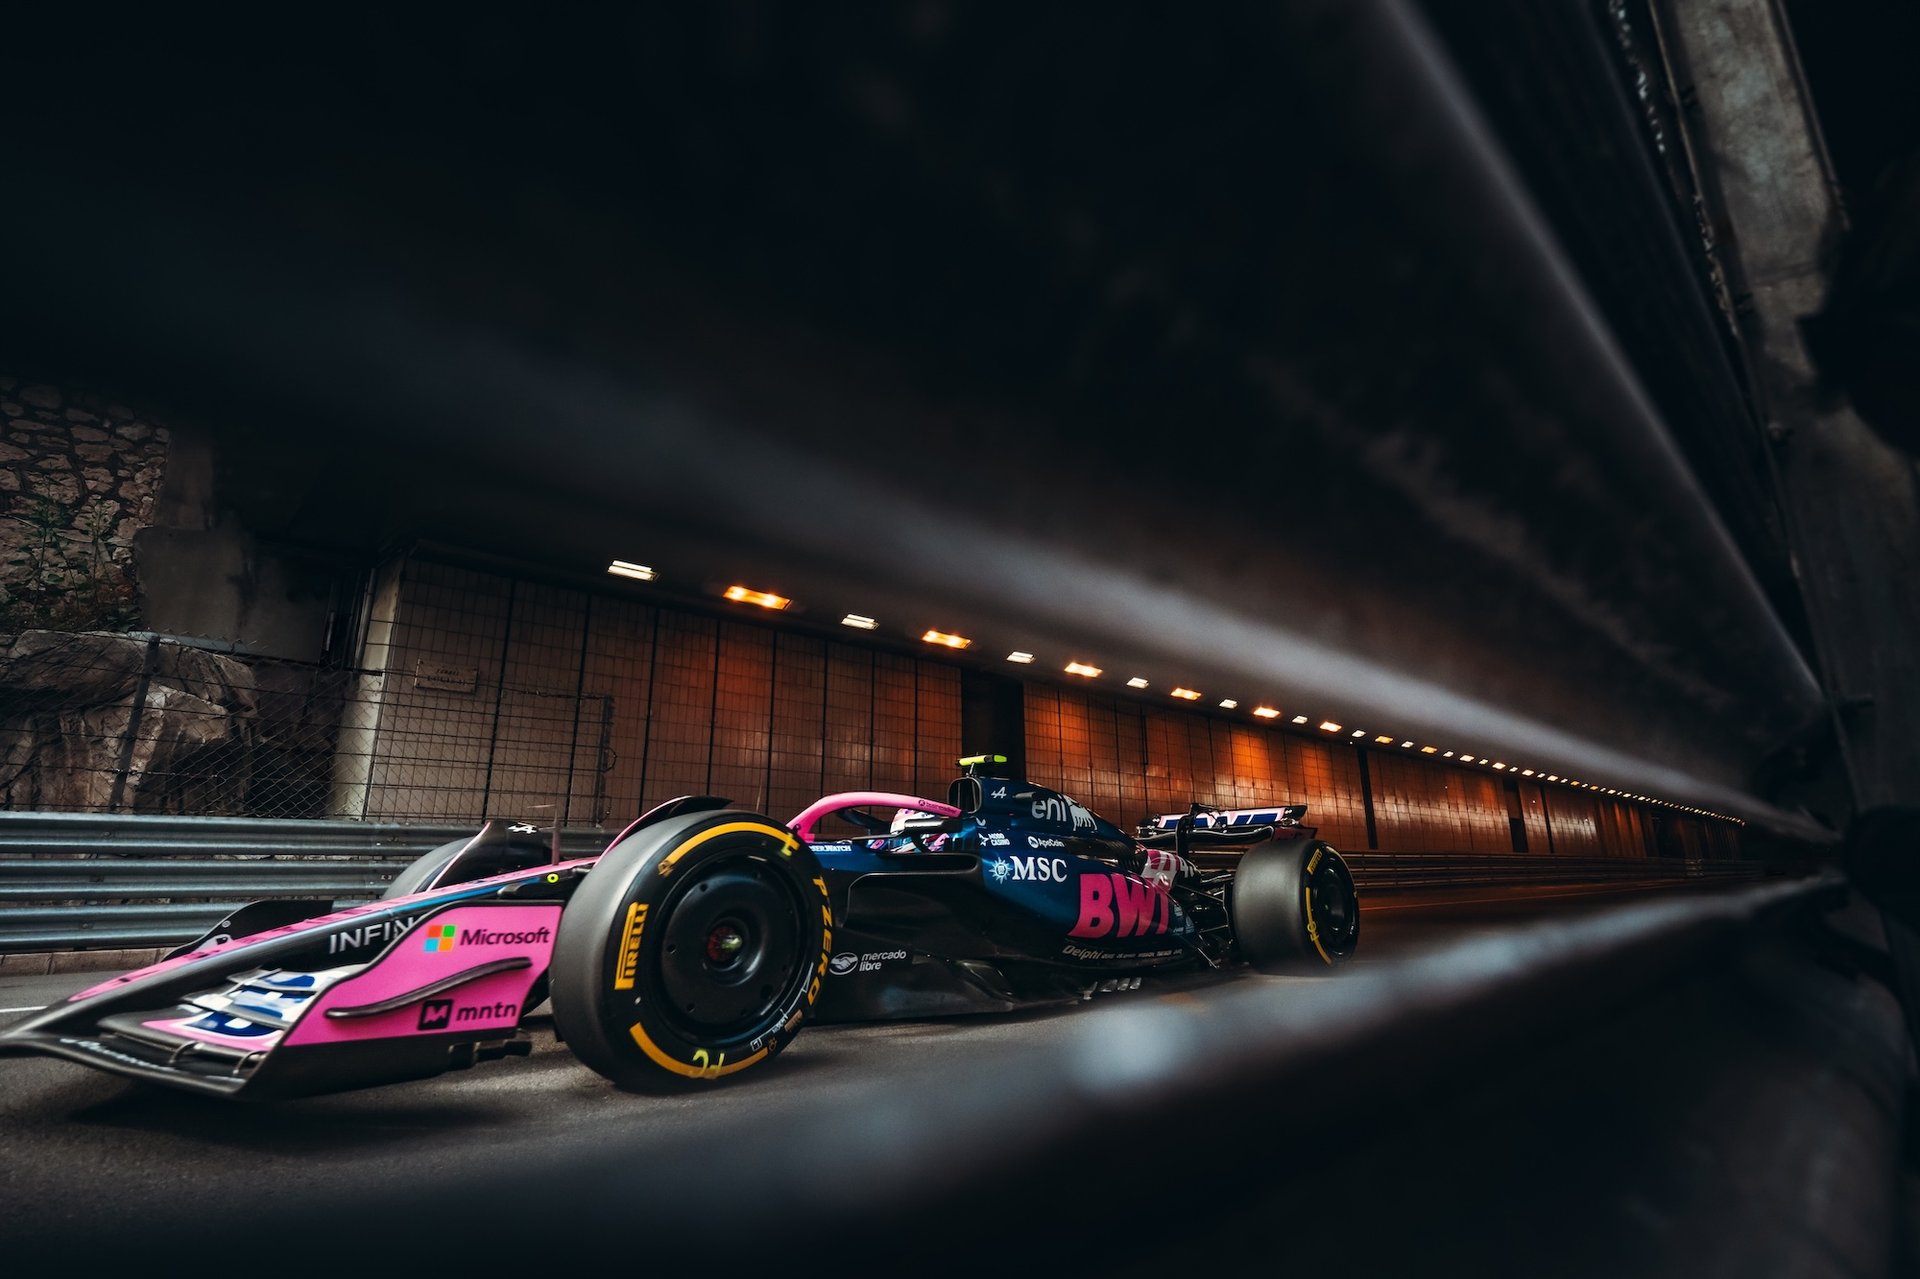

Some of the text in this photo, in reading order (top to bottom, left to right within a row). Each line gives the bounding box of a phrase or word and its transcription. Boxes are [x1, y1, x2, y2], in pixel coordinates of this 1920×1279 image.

[1031, 794, 1067, 822] eni
[1010, 856, 1068, 883] MSC
[329, 916, 414, 954] INFIN
[460, 927, 551, 945] Microsoft
[614, 901, 649, 990] PIRELLI
[807, 876, 832, 1006] P ZERO
[861, 950, 906, 961] mercado
[1062, 945, 1102, 960] Delphi
[859, 961, 882, 972] libre
[456, 1002, 517, 1021] mntn
